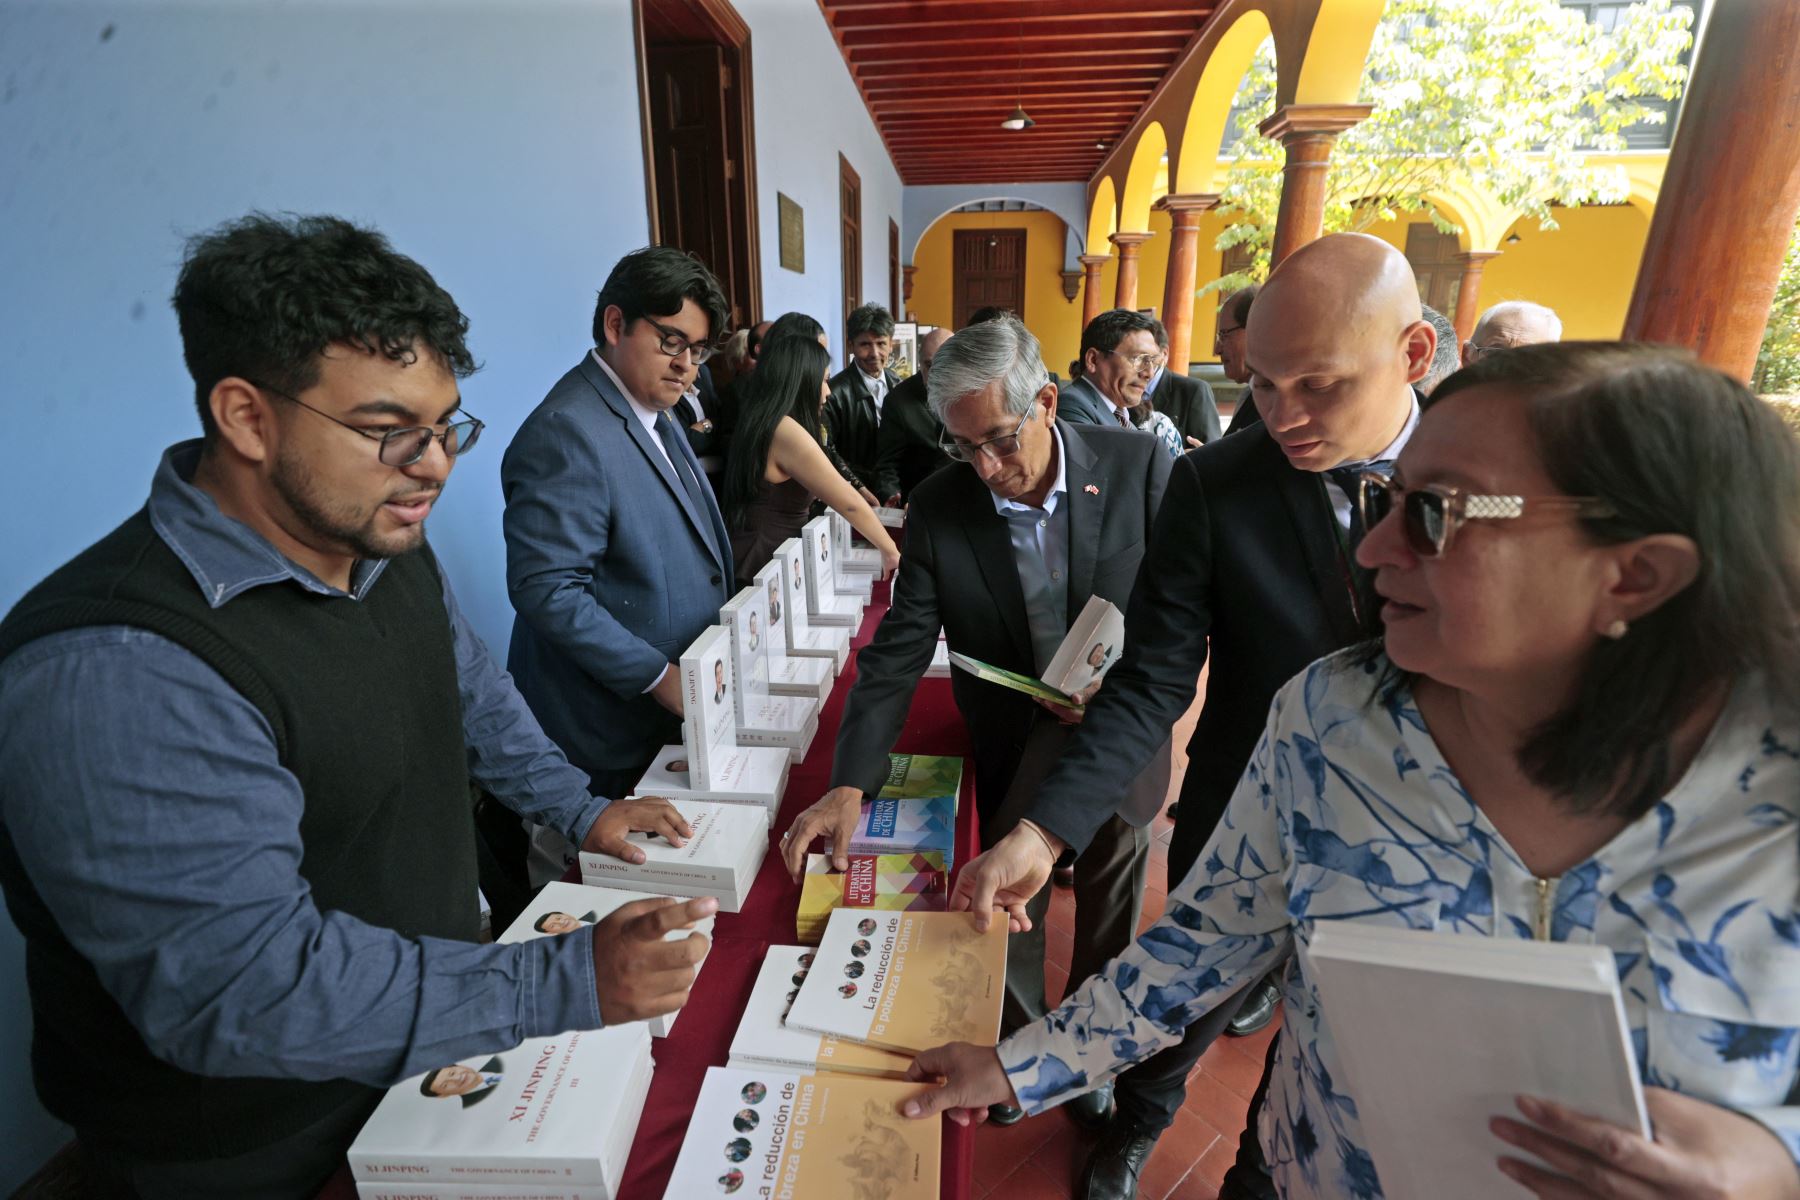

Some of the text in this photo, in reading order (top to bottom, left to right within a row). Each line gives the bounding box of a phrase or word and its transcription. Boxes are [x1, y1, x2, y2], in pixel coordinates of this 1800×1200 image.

[895, 757, 909, 778] CHINA
[872, 801, 885, 833] LITERATURA
[881, 801, 895, 828] CHINA
[599, 863, 628, 872] JINPING
[848, 859, 861, 900] LITERATURA
[859, 859, 873, 904] DE CHINA
[862, 917, 899, 1010] La reducción de
[871, 918, 913, 1036] la pobreza en China
[819, 1046, 834, 1058] la
[509, 1045, 556, 1121] XI JINPING
[526, 1030, 582, 1143] THE GOVERNANCE OF CHIN
[569, 1078, 580, 1088] III
[794, 1083, 815, 1127] China
[758, 1081, 796, 1200] a reducción de
[791, 1130, 806, 1150] en
[366, 1164, 430, 1174] XI JINPING
